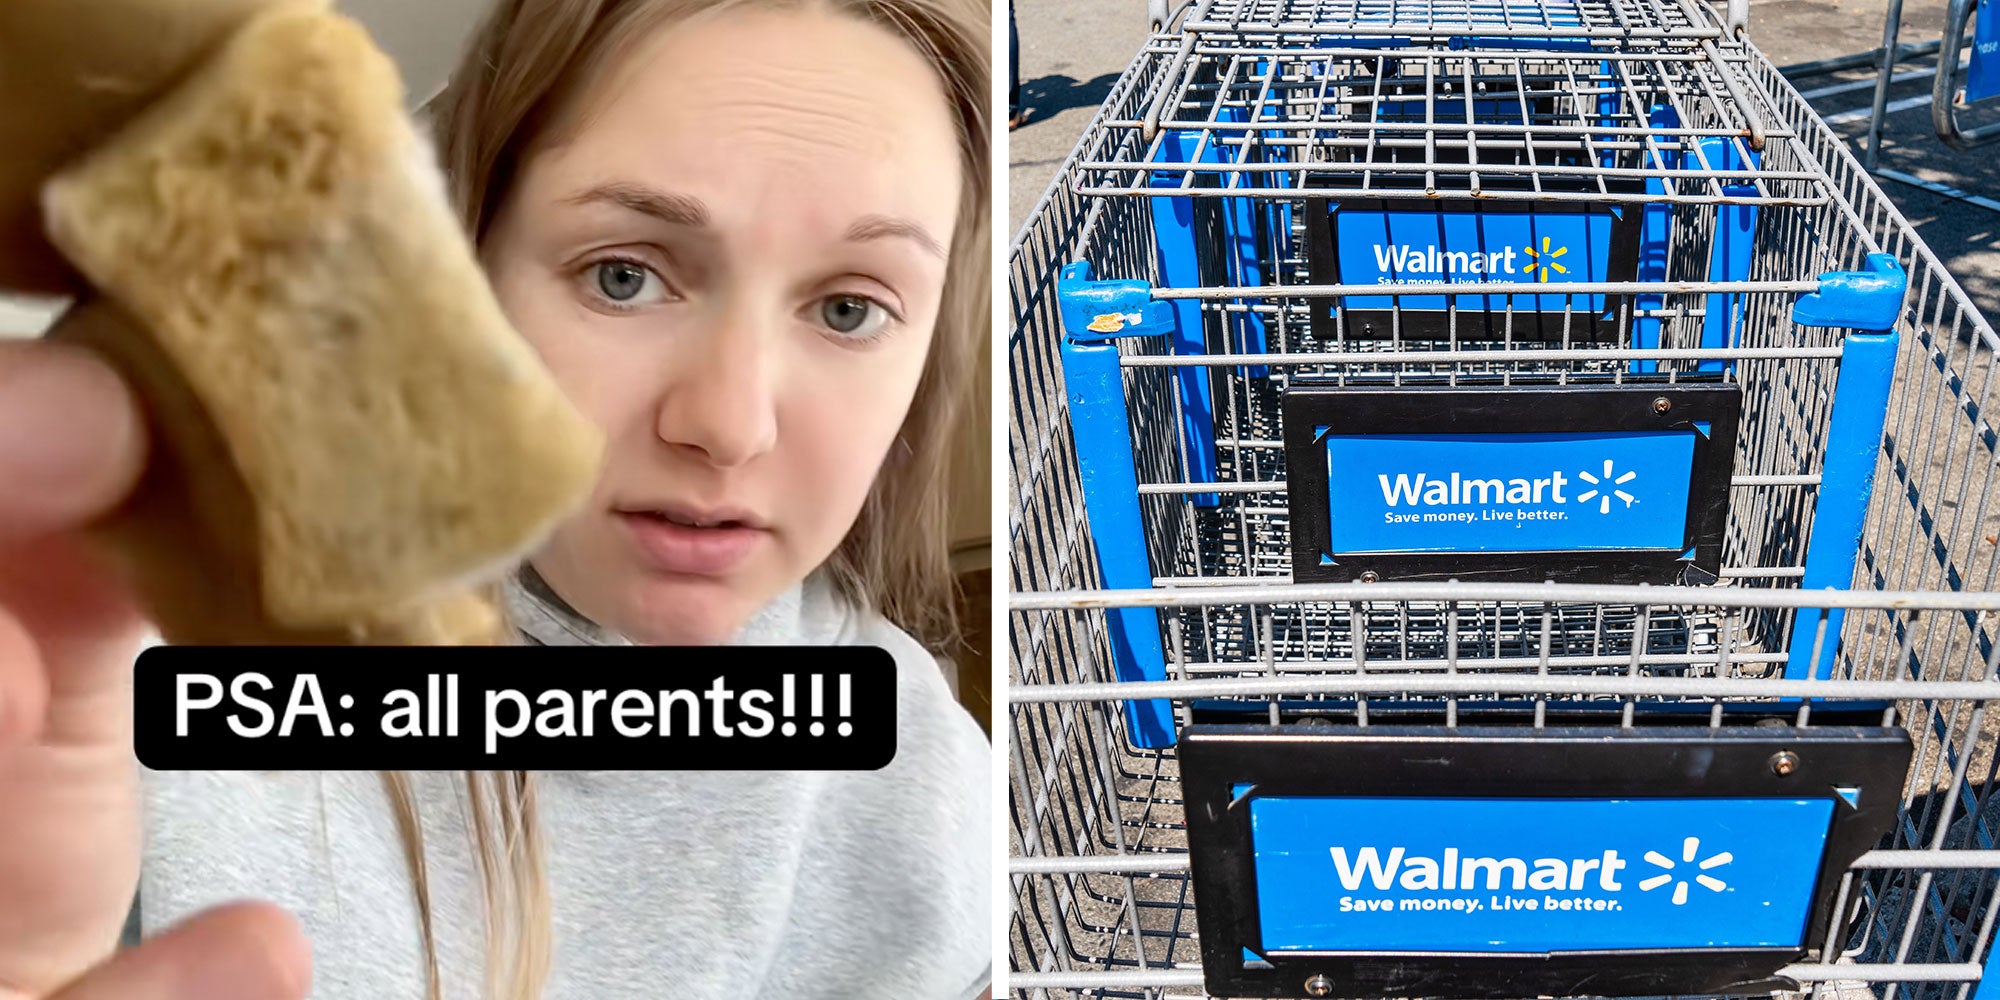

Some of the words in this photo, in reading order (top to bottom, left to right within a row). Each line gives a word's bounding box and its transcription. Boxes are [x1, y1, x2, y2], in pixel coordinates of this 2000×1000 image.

[1373, 244, 1517, 274] Walmart
[1377, 471, 1568, 507] Walmart
[1384, 511, 1421, 524] Save
[1423, 513, 1479, 524] money.
[1482, 509, 1514, 521] Live
[1517, 508, 1569, 521] better.
[1329, 846, 1627, 892] Walmart
[1339, 896, 1395, 912] Save
[1399, 898, 1484, 914] money.
[1490, 895, 1539, 911] Live
[1543, 895, 1623, 911] better.
